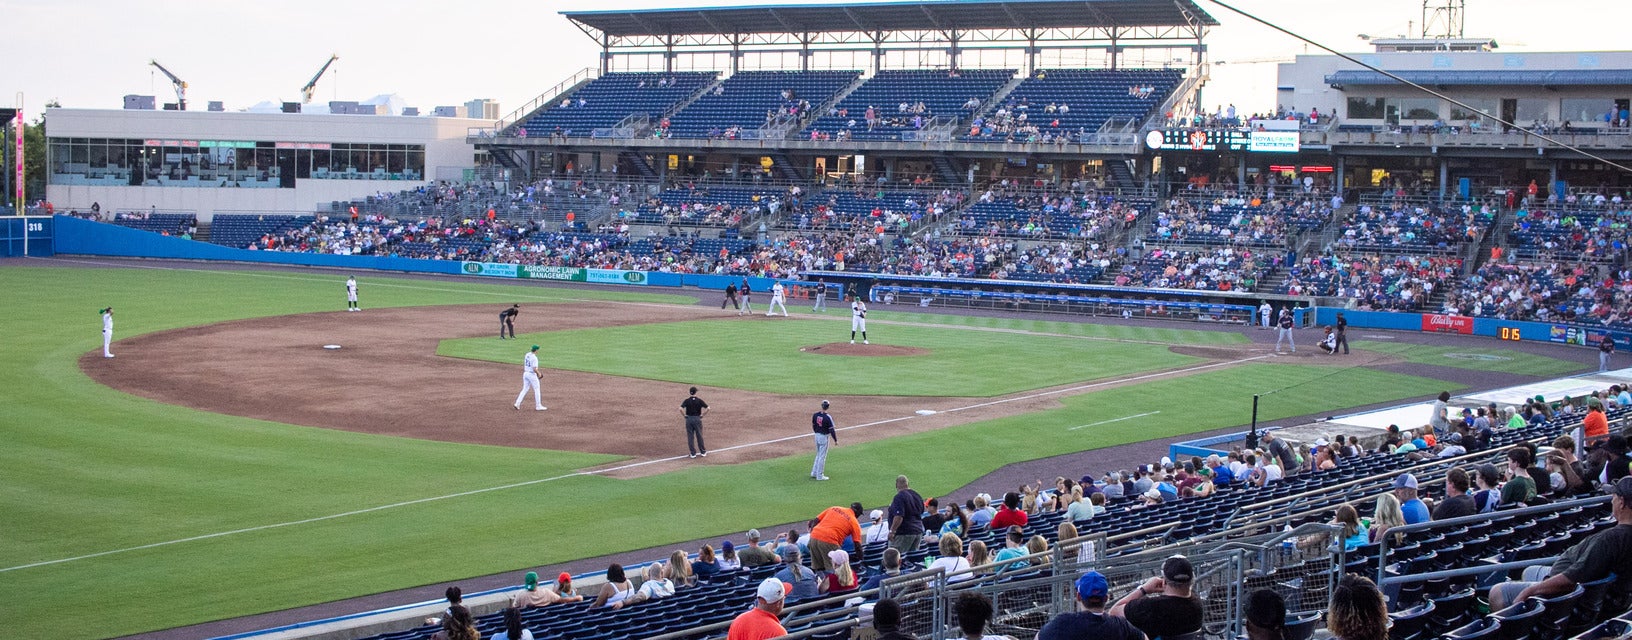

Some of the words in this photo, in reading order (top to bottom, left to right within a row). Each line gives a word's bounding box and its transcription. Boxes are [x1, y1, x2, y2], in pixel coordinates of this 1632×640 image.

[28, 222, 43, 231] 318
[468, 262, 479, 273] ALM
[523, 265, 561, 274] AGRONOMIC
[562, 267, 580, 275] LAWN
[530, 272, 572, 280] MANAGEMENT
[628, 272, 640, 282] ALM
[1511, 328, 1520, 340] 15
